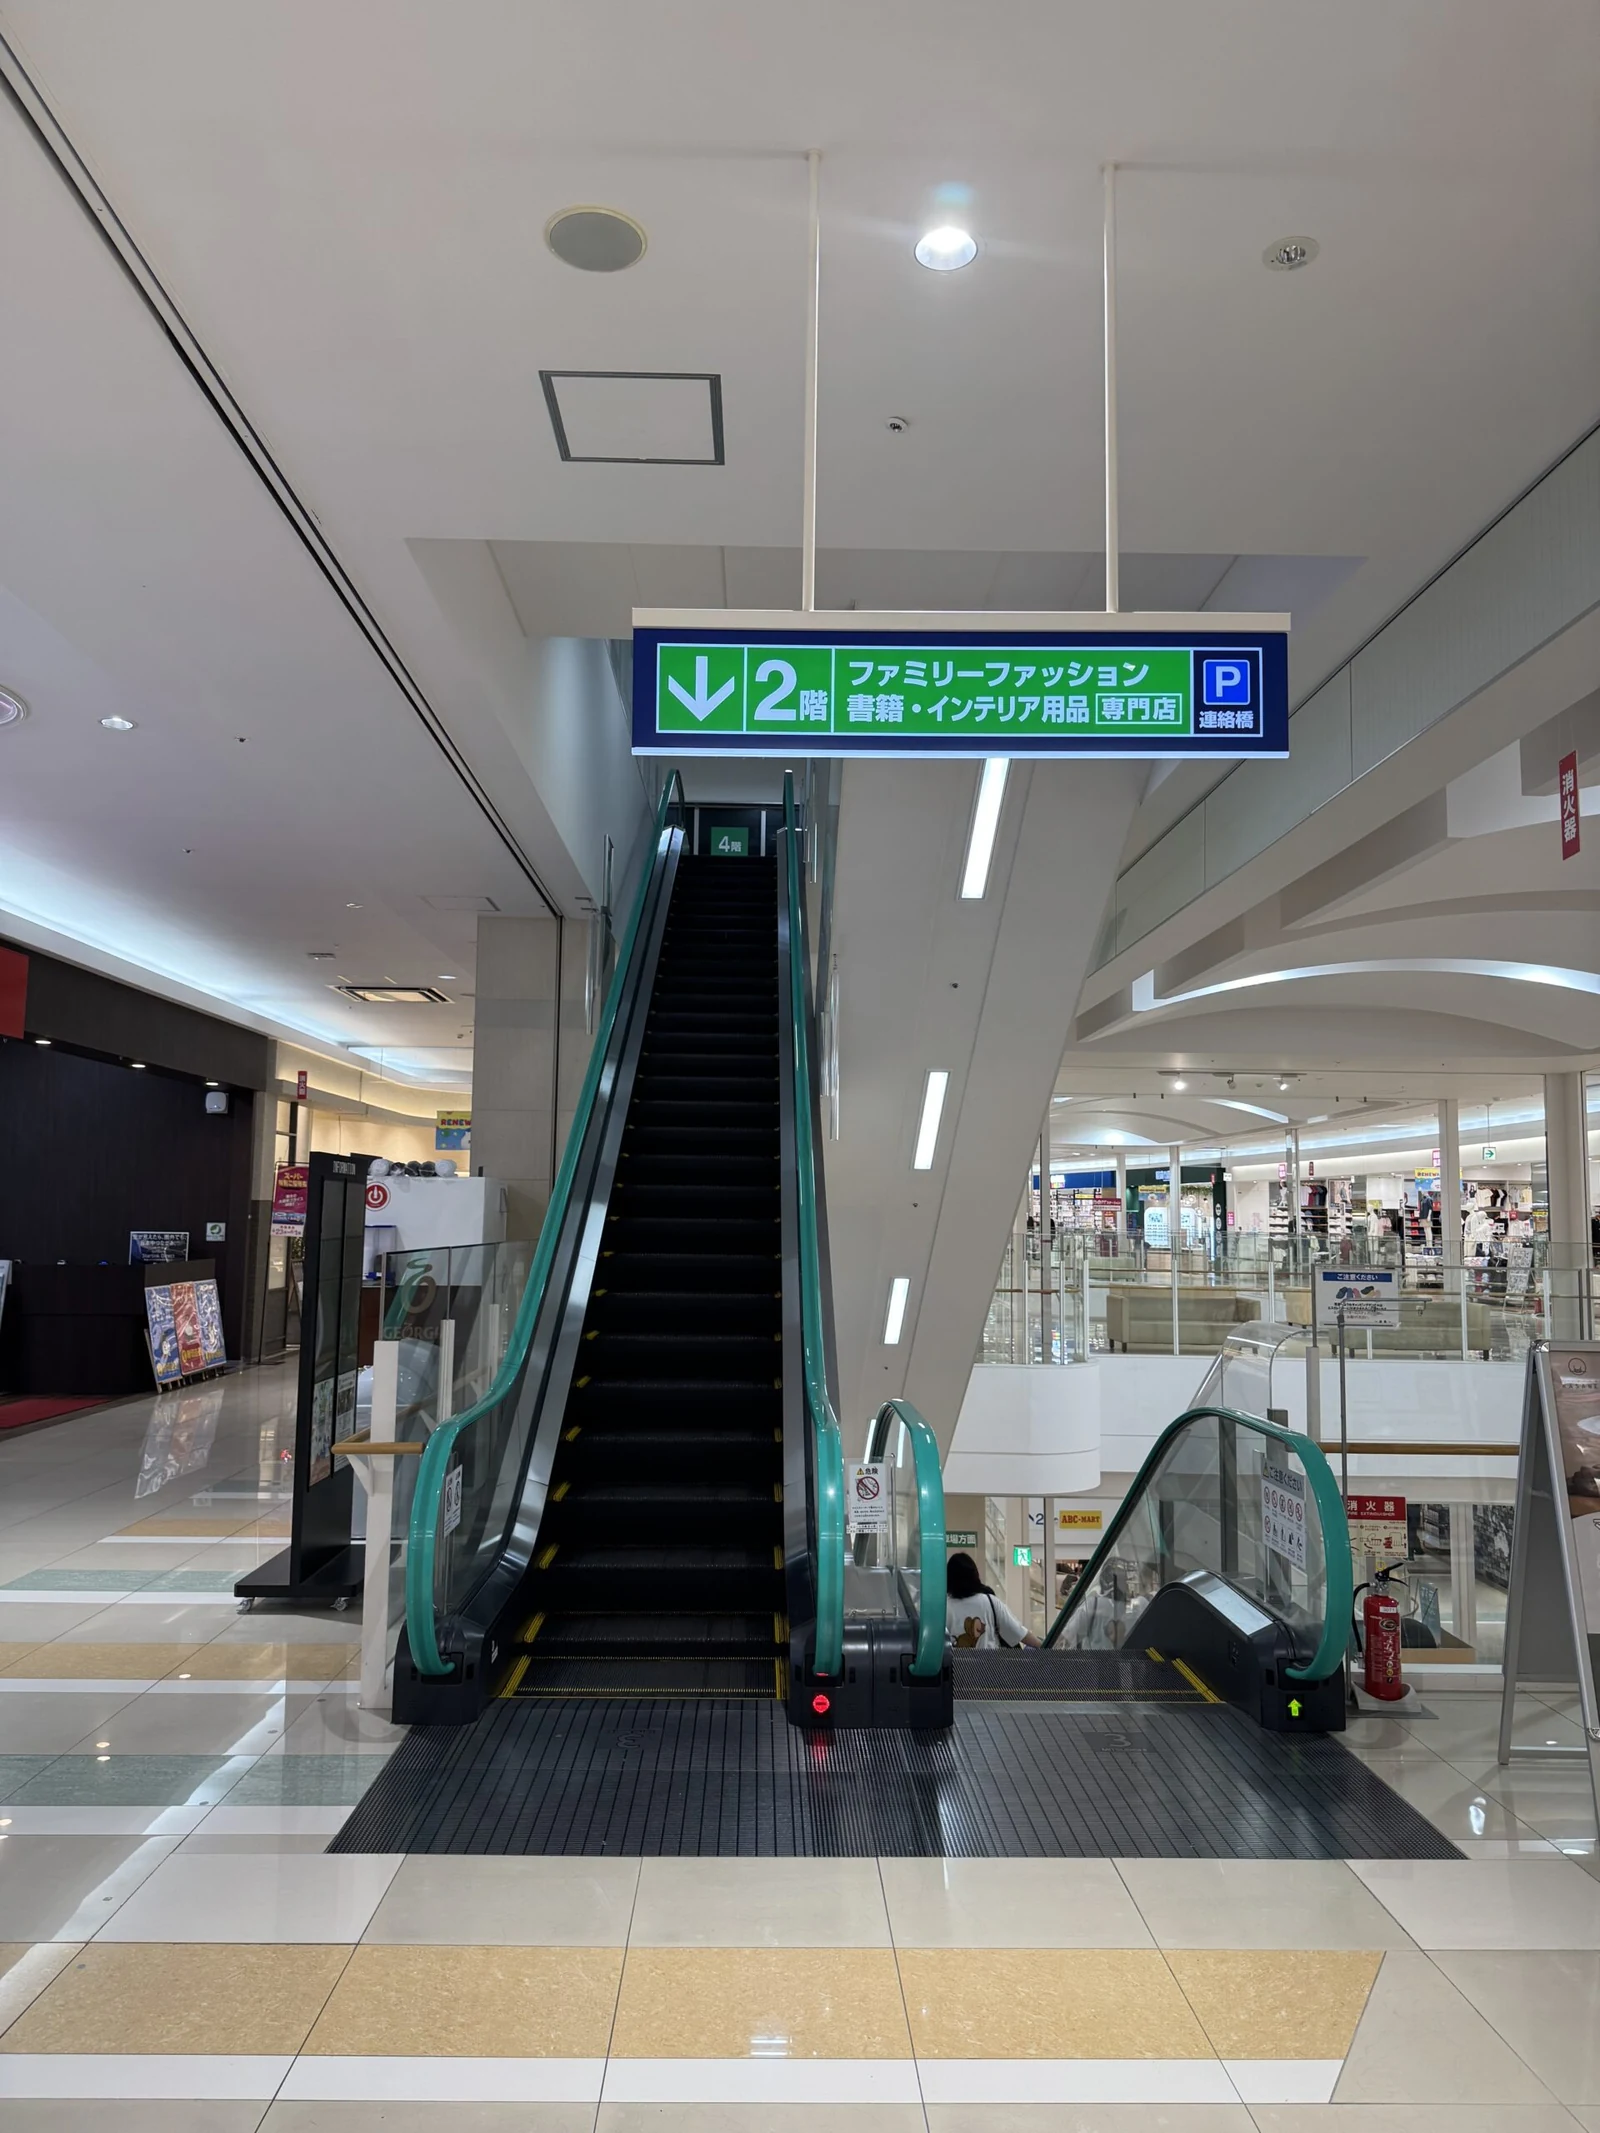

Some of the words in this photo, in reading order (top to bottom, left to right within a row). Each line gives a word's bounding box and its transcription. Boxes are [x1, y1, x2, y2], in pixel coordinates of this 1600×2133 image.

[849, 660, 1149, 688] ファミリーファッション
[1215, 665, 1241, 697] P
[754, 659, 828, 721] 2階
[846, 694, 1090, 723] 書籍・インテリア用品
[1101, 697, 1176, 721] 専門店
[1199, 710, 1254, 729] 連絡橋
[1562, 769, 1577, 843] 消火器
[718, 835, 742, 853] 4階
[1336, 1273, 1379, 1281] ご注意ください
[865, 1467, 879, 1475] 危険
[1269, 1466, 1303, 1492] ご注意ください
[1347, 1500, 1395, 1511] 消火器
[1061, 1514, 1101, 1524] ABC-MART
[1104, 1733, 1132, 1747] 3
